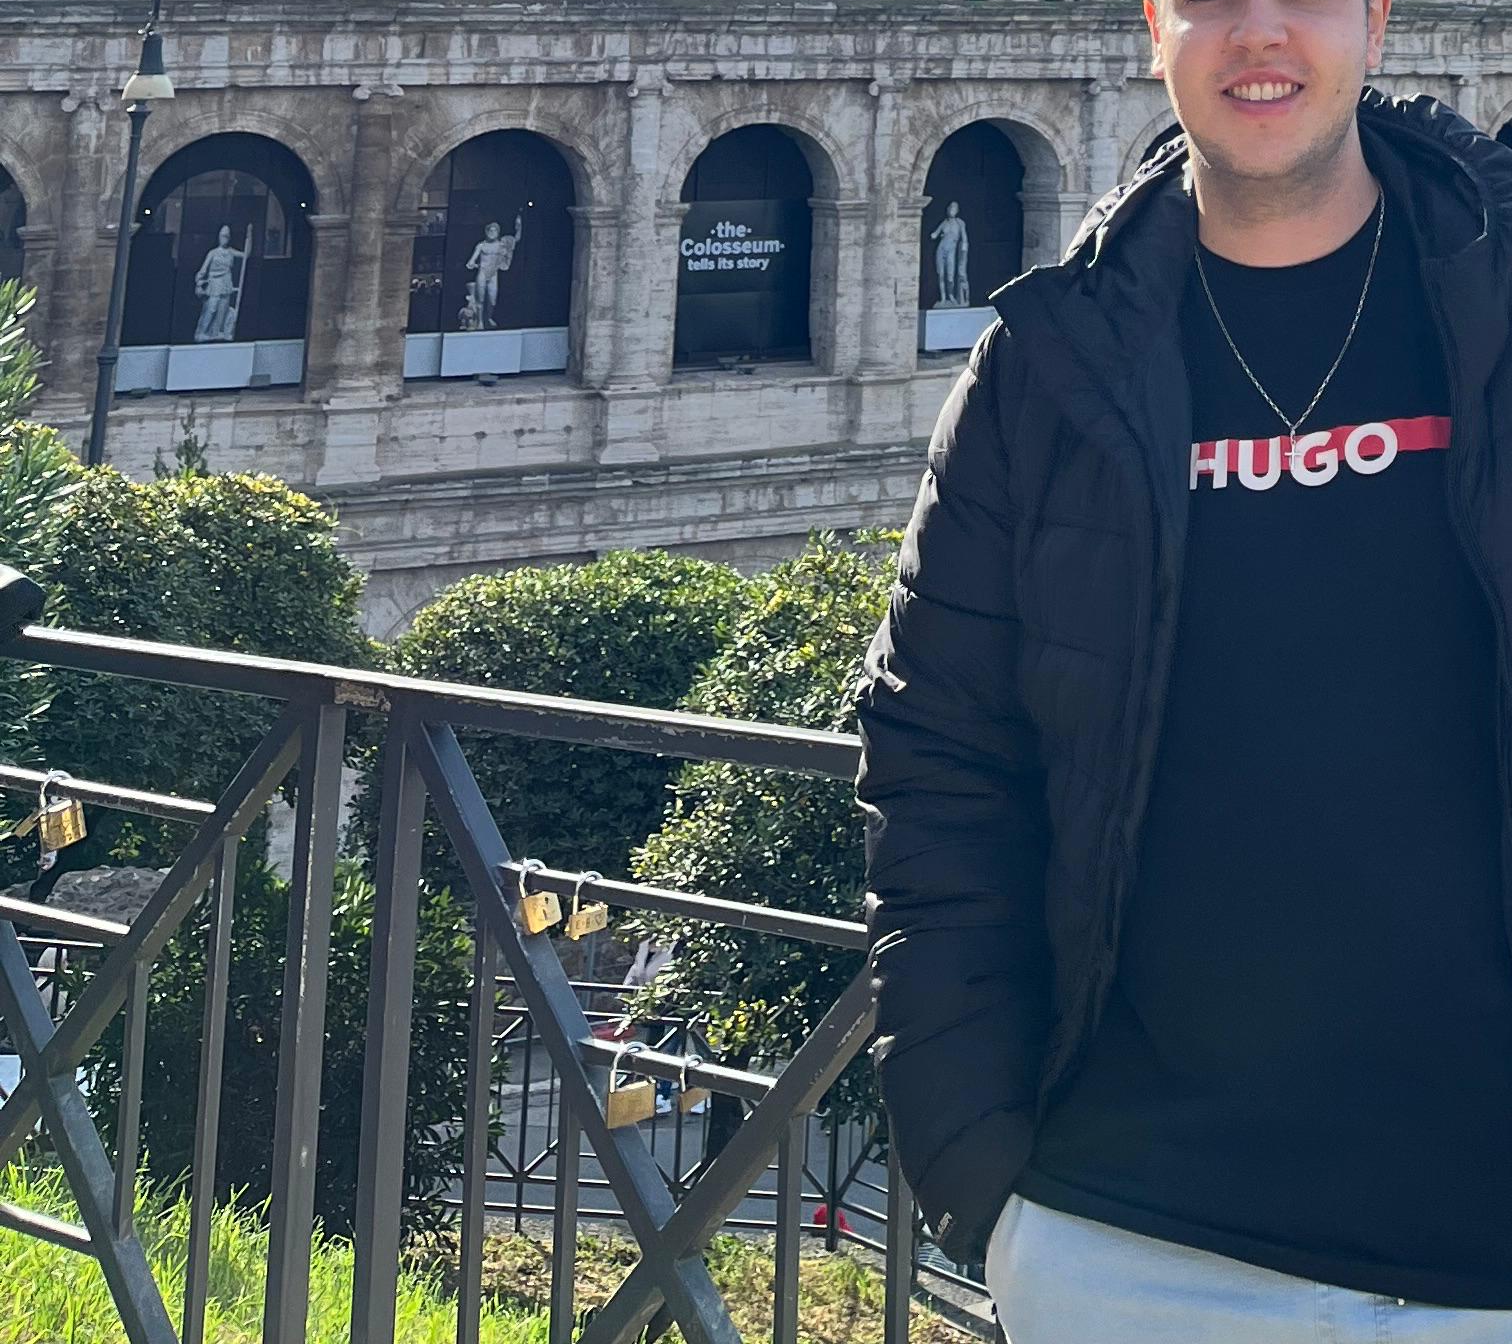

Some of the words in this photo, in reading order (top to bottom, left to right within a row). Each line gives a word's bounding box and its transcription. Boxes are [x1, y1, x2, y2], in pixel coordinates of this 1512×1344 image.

[716, 221, 746, 237] the
[681, 238, 779, 255] Colosseum
[688, 258, 715, 270] tells
[717, 257, 735, 269] its
[736, 256, 770, 270] story
[1189, 422, 1398, 491] HUGO
